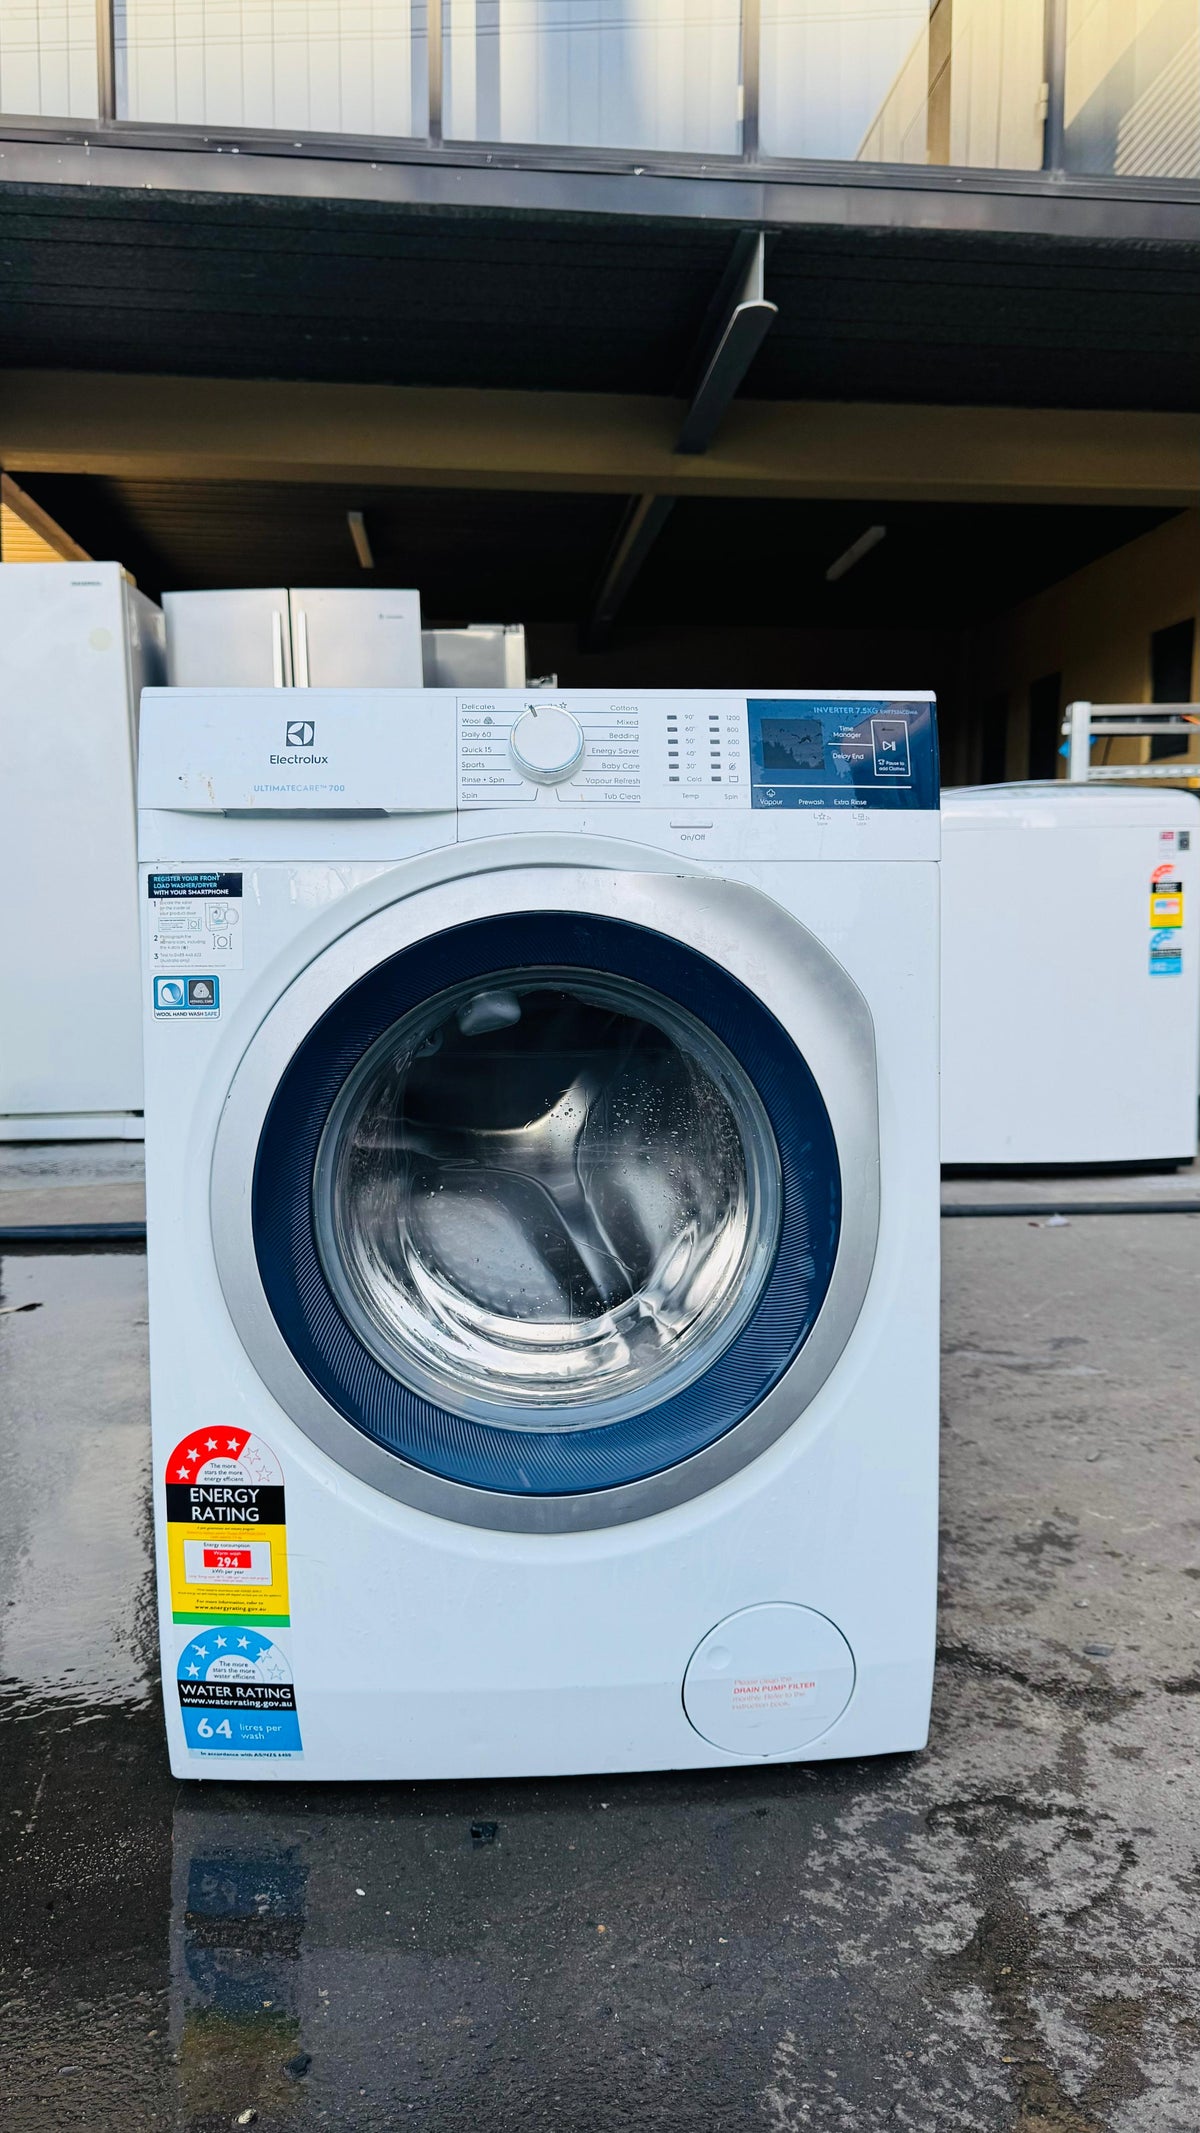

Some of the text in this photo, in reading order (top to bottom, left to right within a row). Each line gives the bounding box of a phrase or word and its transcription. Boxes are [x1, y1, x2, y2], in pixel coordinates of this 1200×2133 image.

[270, 754, 328, 765] Electrolux
[190, 1488, 260, 1503] ENERGY
[192, 1507, 260, 1522] RATING
[217, 1557, 238, 1567] 294
[180, 1684, 291, 1699] WATER RATING
[182, 1697, 292, 1708] www.waterrating.gov.au
[197, 1718, 232, 1739] 64
